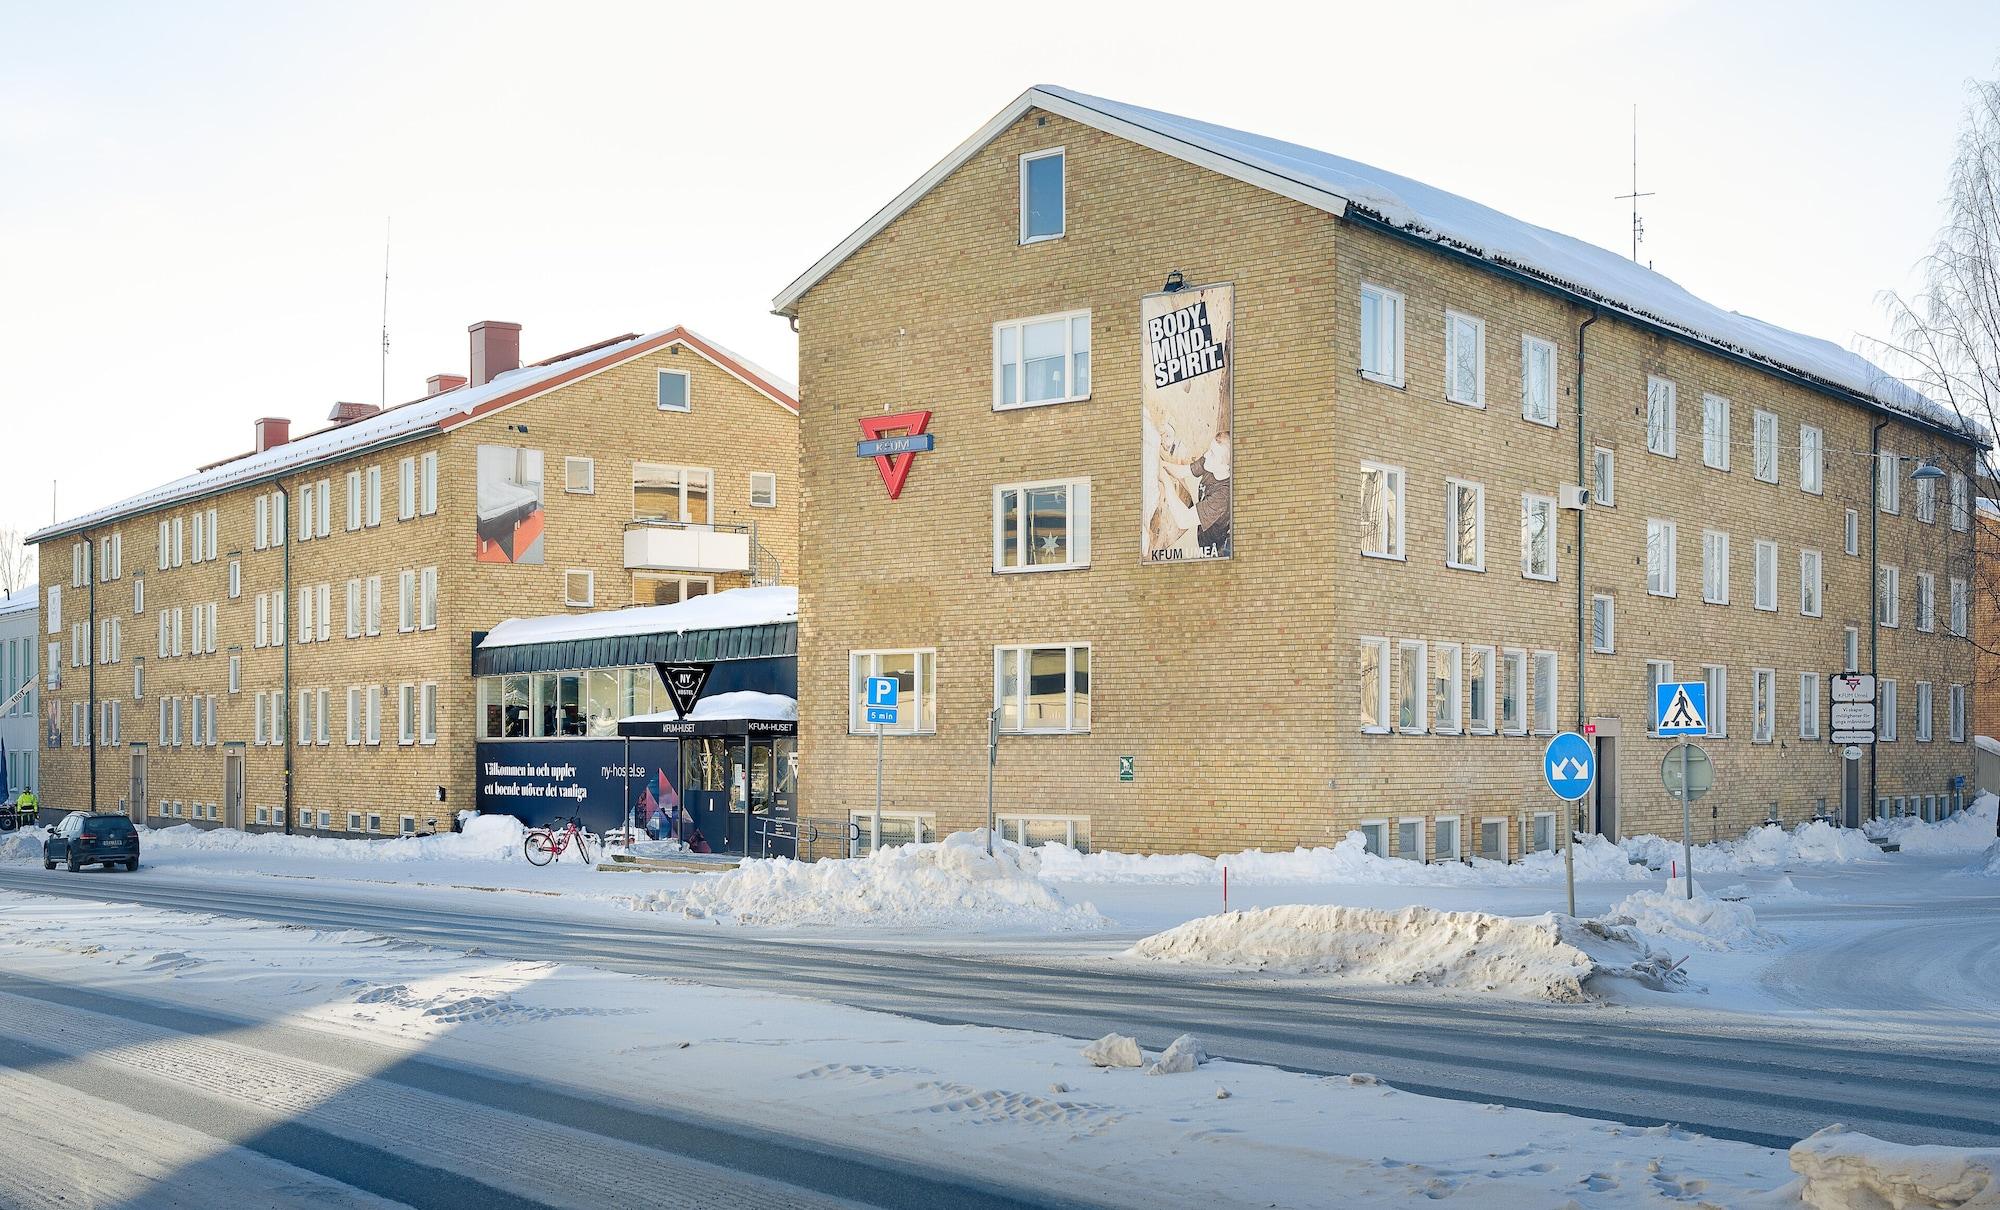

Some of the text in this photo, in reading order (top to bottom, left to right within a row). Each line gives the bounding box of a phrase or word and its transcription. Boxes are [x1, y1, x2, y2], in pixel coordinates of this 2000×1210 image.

[1149, 303, 1206, 343] BODY.
[1151, 327, 1211, 365] MIND.
[1155, 345, 1224, 387] SPIRIT.
[876, 439, 909, 452] KFUM
[1151, 548, 1183, 561] KFUM
[680, 673, 691, 684] NY
[876, 679, 892, 703] P
[871, 711, 893, 720] 5 min
[662, 723, 696, 733] KFUM-HUSET
[748, 722, 793, 732] KFUM-HUSET
[484, 762, 577, 781] Välkommen in och upplev
[601, 763, 646, 780] ny-hosel.se
[484, 782, 588, 802] ett boende utöver det vanliga
